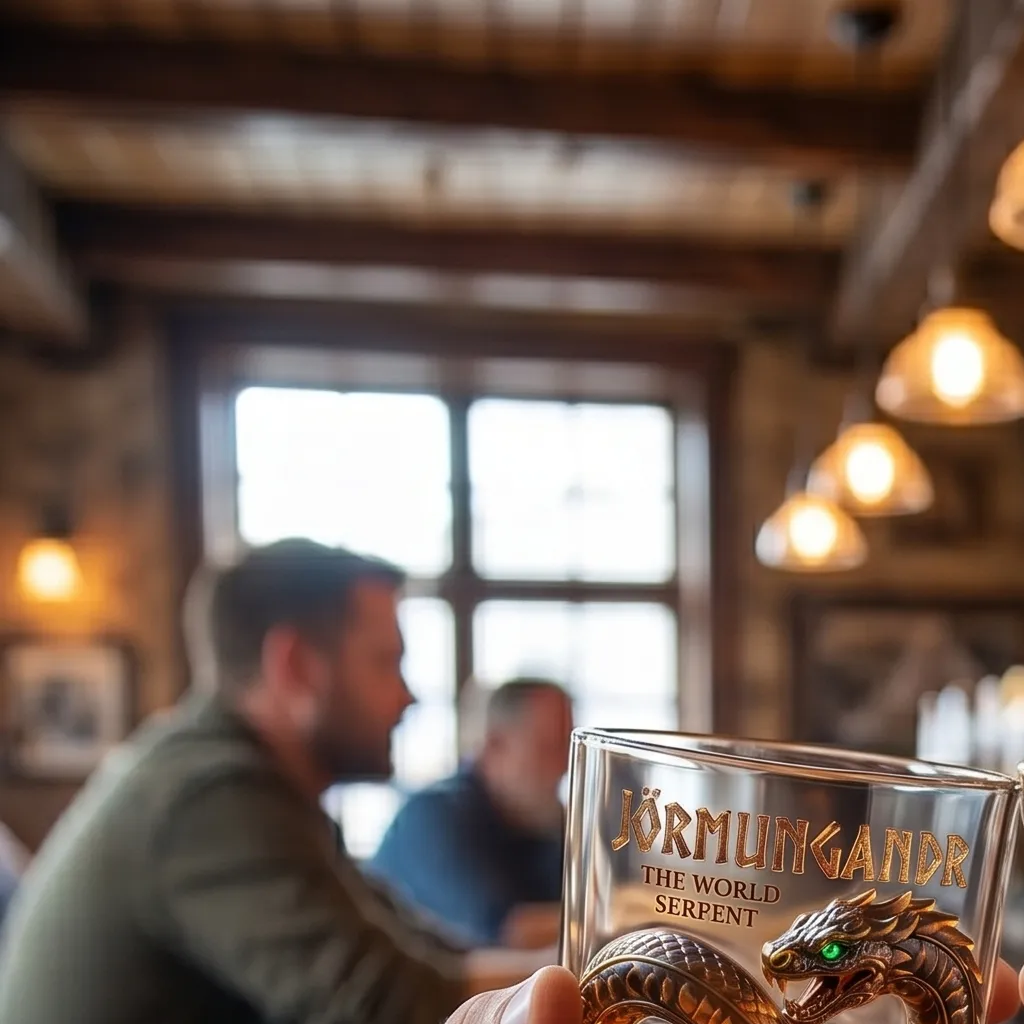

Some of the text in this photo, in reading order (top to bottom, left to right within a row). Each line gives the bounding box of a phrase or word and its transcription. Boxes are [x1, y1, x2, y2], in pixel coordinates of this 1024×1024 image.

[611, 786, 970, 888] JÖRMUNGANDR
[641, 864, 780, 904] THE WORLD
[655, 894, 759, 928] SERPENT
